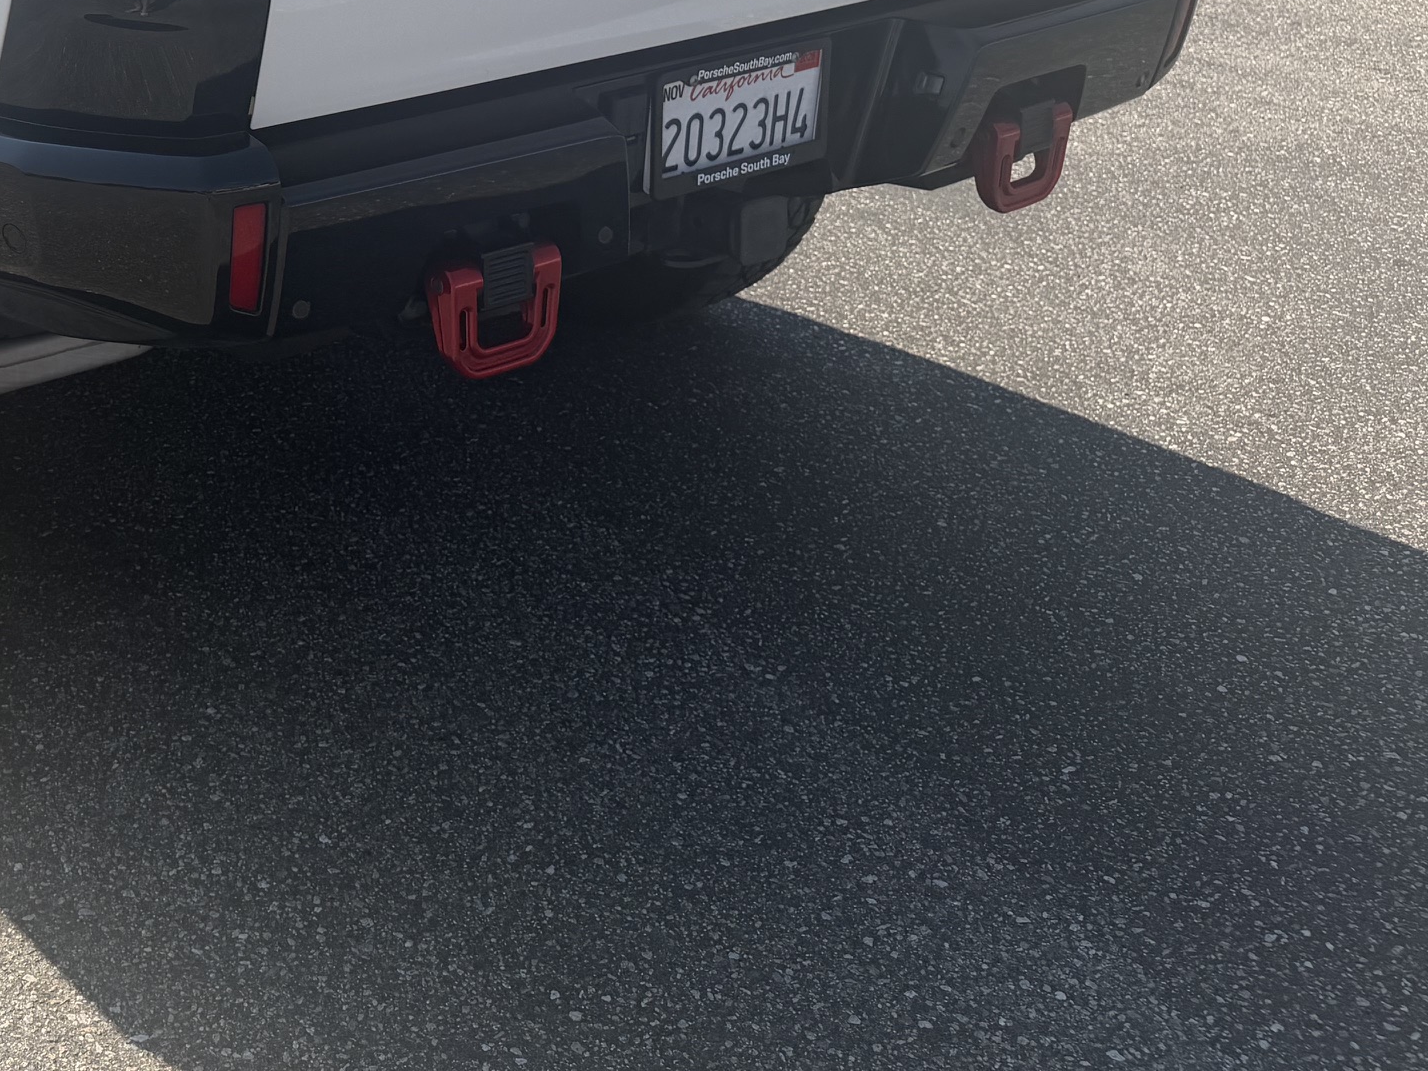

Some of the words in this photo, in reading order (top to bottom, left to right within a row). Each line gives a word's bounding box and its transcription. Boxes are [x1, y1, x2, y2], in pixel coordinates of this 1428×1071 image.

[697, 51, 793, 81] PorscheSouthBay.com
[663, 84, 685, 102] NOV
[689, 65, 794, 102] California
[661, 87, 808, 173] 20323H4
[697, 168, 739, 186] Porsche
[740, 158, 770, 175] South
[772, 152, 791, 167] Bay
